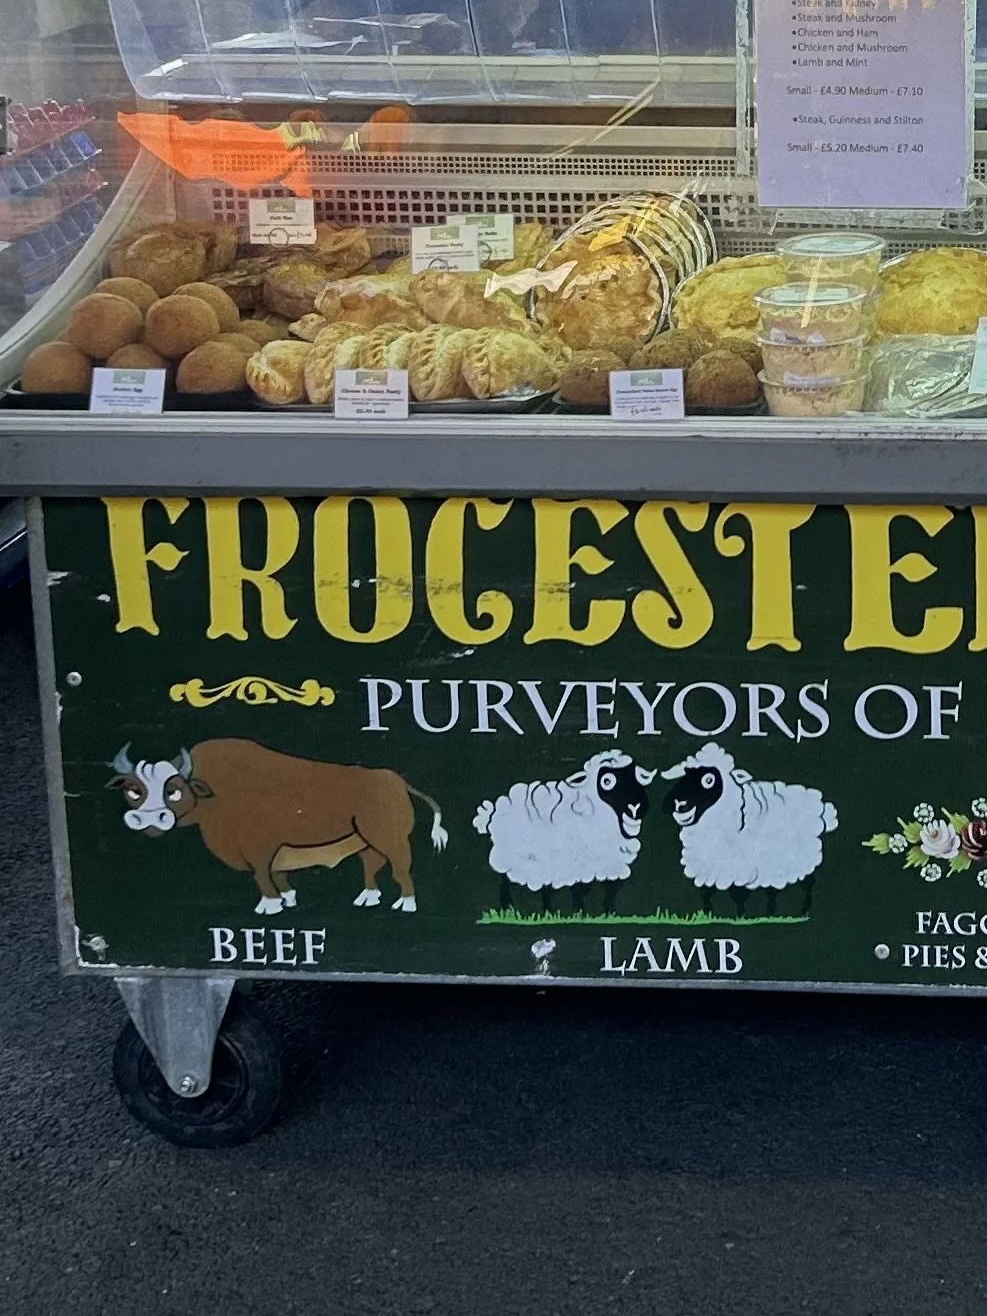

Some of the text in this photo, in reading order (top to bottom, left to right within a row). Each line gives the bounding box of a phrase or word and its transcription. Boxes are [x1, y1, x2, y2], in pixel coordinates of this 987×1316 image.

[797, 0, 822, 7] Steak
[825, 0, 843, 7] and
[797, 13, 896, 22] Steak and Mushroom
[797, 28, 878, 37] Chicken and Ham
[797, 43, 908, 52] Chicken and Mushroom
[797, 58, 868, 67] Lamb and Mint
[786, 85, 812, 94] Small
[820, 86, 846, 95] £4.90
[849, 86, 888, 95] Medium
[798, 115, 924, 125] Steak, Guinness and Stilton
[787, 143, 812, 152] Small
[849, 144, 888, 153] Medium
[359, 677, 830, 743] PURVEYORS
[854, 681, 963, 741] OF
[209, 927, 328, 966] BEEF
[600, 937, 743, 976] LAMB
[901, 944, 966, 971] PIES
